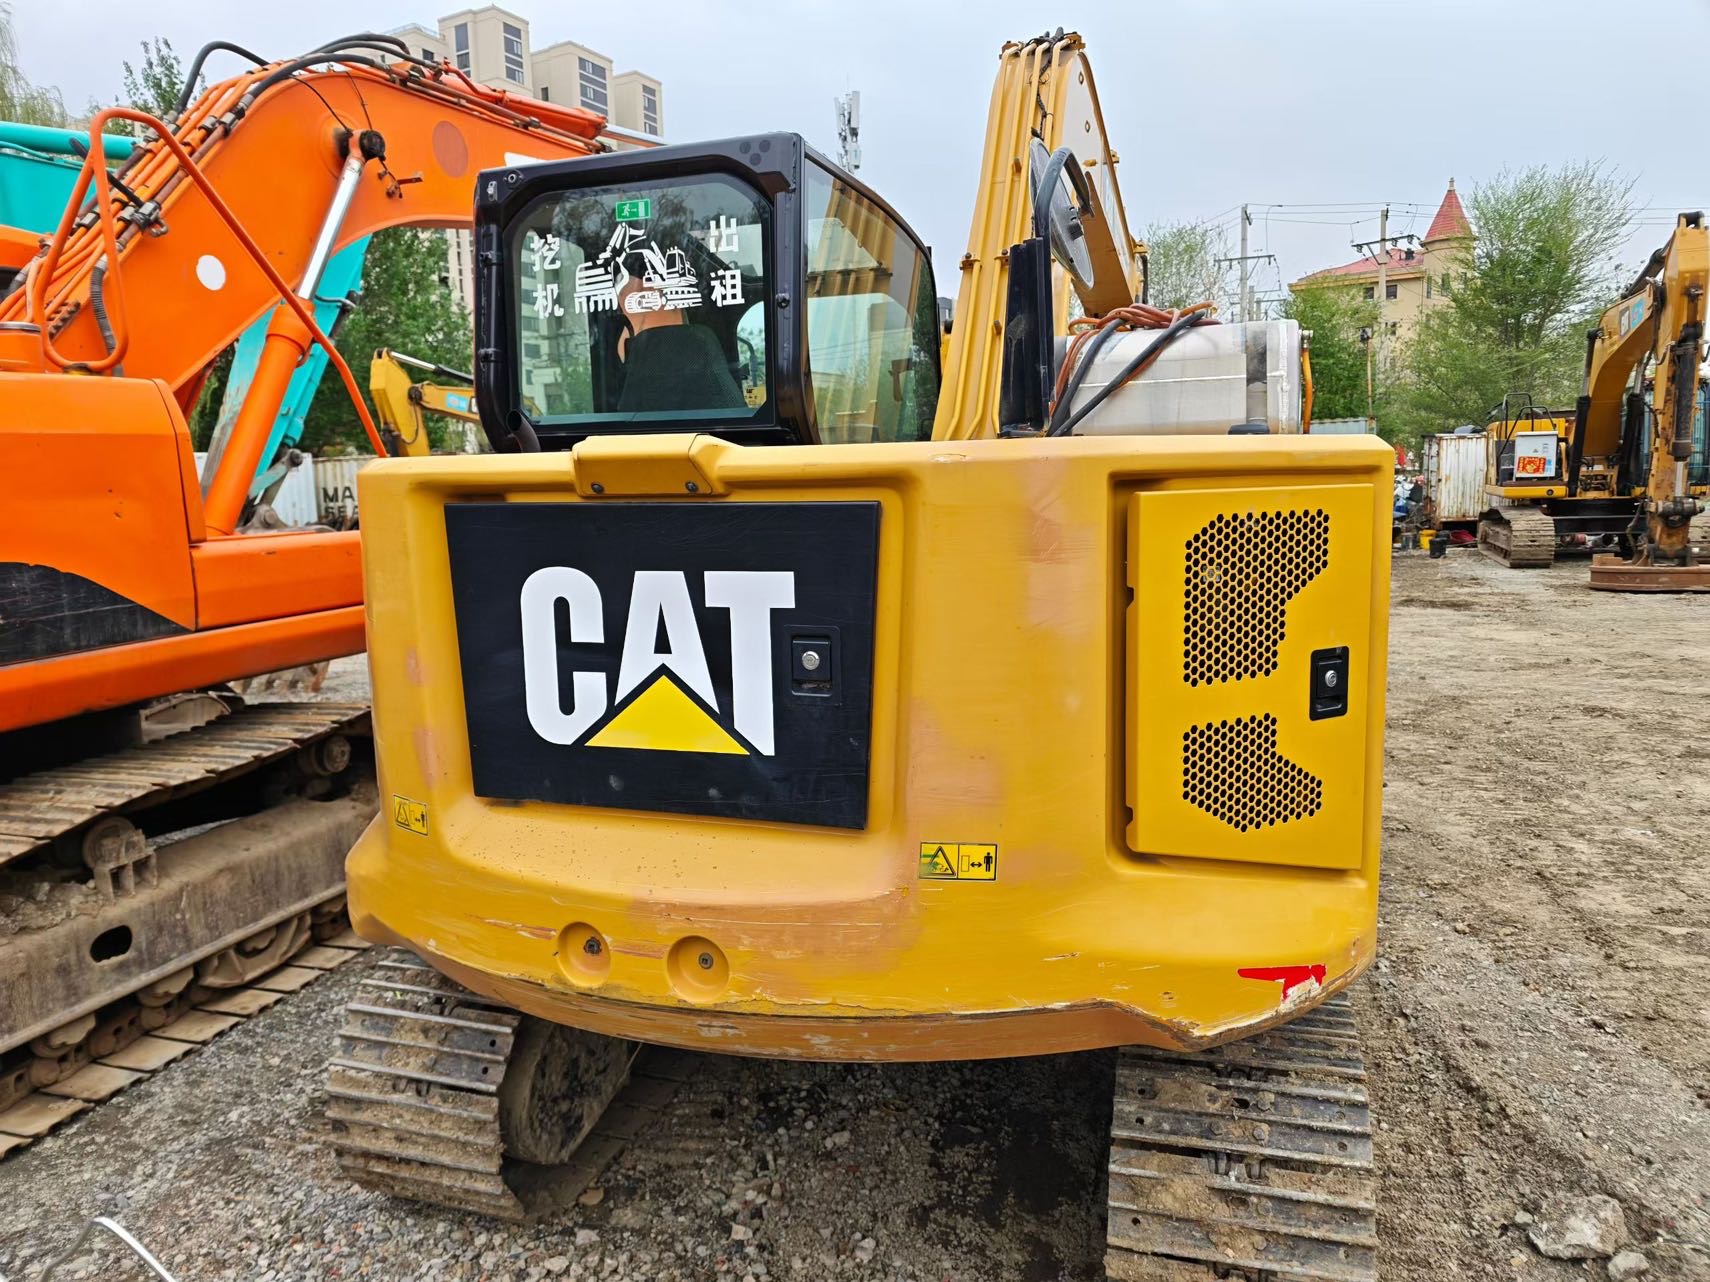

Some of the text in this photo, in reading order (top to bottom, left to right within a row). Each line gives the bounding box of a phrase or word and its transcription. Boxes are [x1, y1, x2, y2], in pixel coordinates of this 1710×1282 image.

[530, 234, 564, 319] 挖机
[322, 486, 355, 503] MA
[520, 566, 796, 757] CAT
